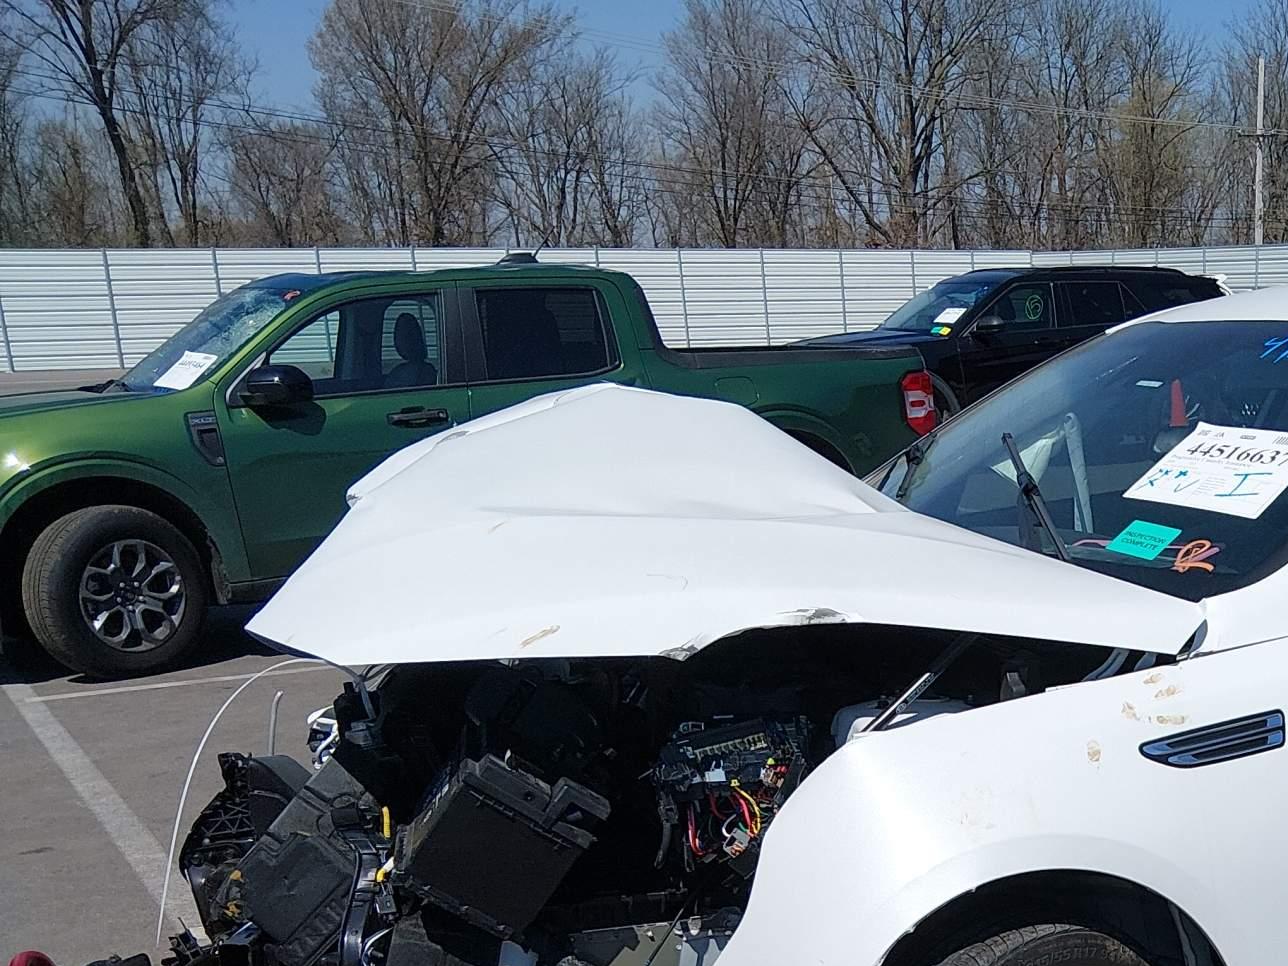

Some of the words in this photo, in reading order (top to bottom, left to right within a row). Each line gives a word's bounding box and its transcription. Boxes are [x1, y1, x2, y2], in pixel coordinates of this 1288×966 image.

[1214, 472, 1273, 496] I
[1121, 537, 1158, 550] COMPLETE
[1123, 531, 1166, 544] INSPECTION
